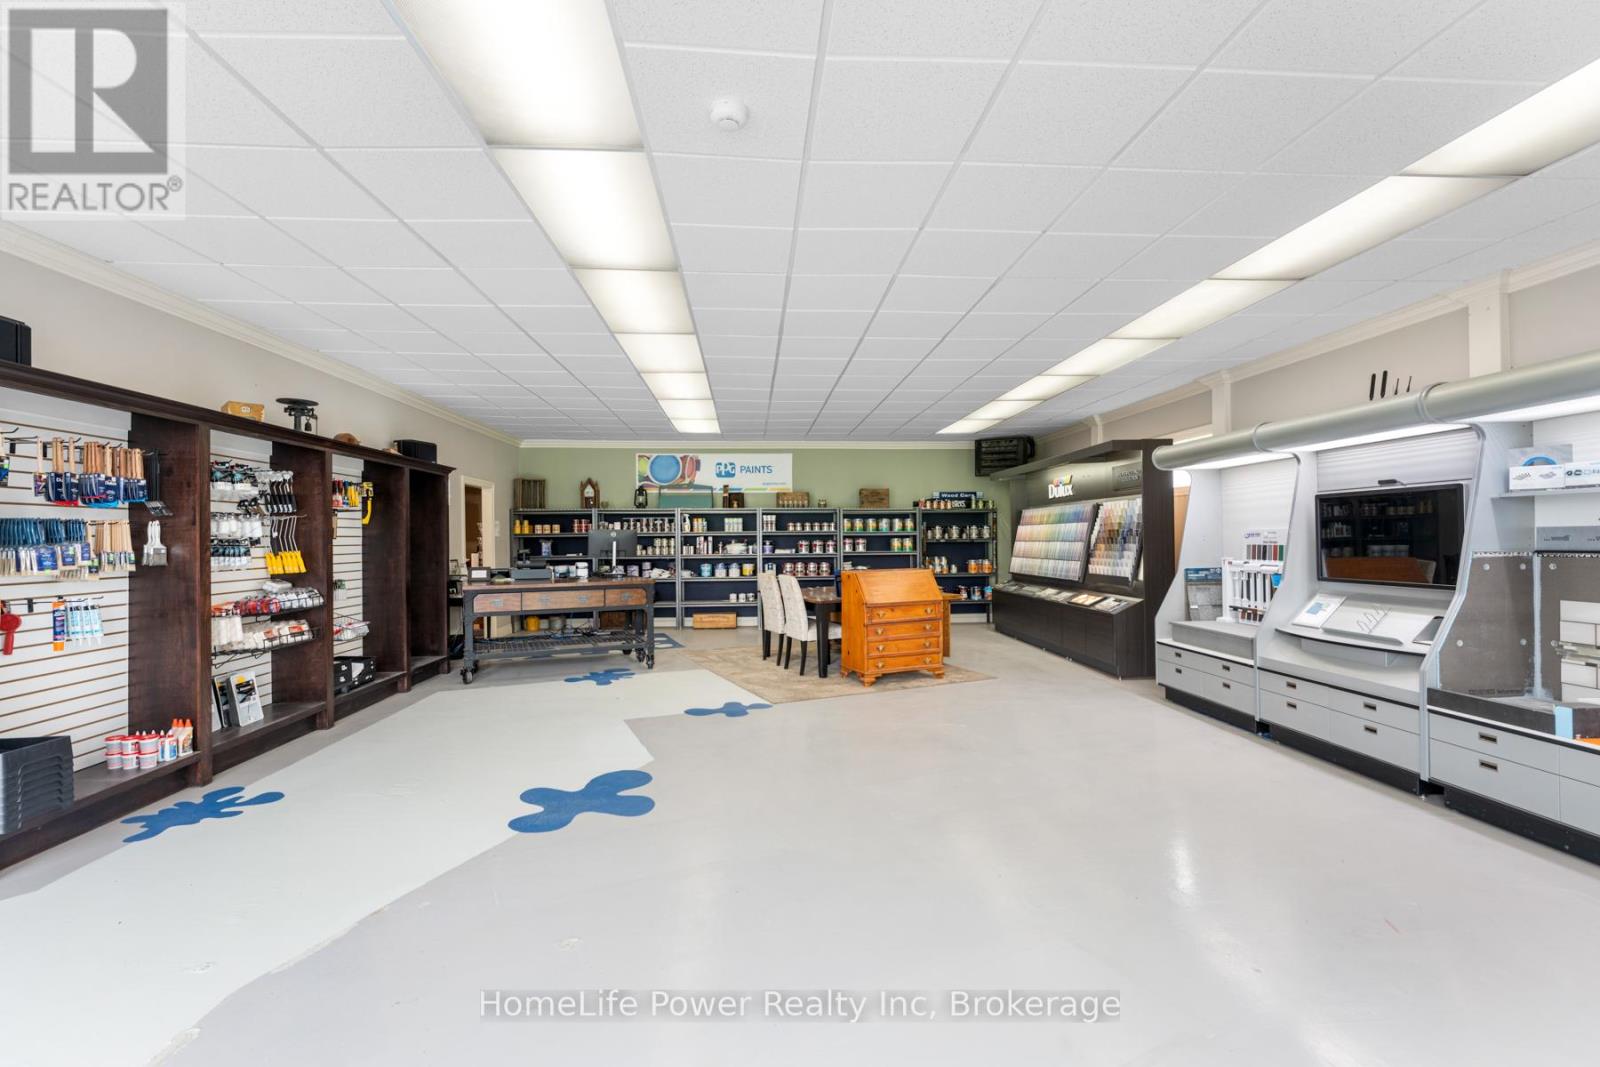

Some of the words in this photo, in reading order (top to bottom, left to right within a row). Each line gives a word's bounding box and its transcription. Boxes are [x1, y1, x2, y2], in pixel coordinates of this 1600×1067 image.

[715, 462, 736, 478] PPG
[740, 465, 773, 474] PAINTS
[1048, 483, 1074, 499] Dulux
